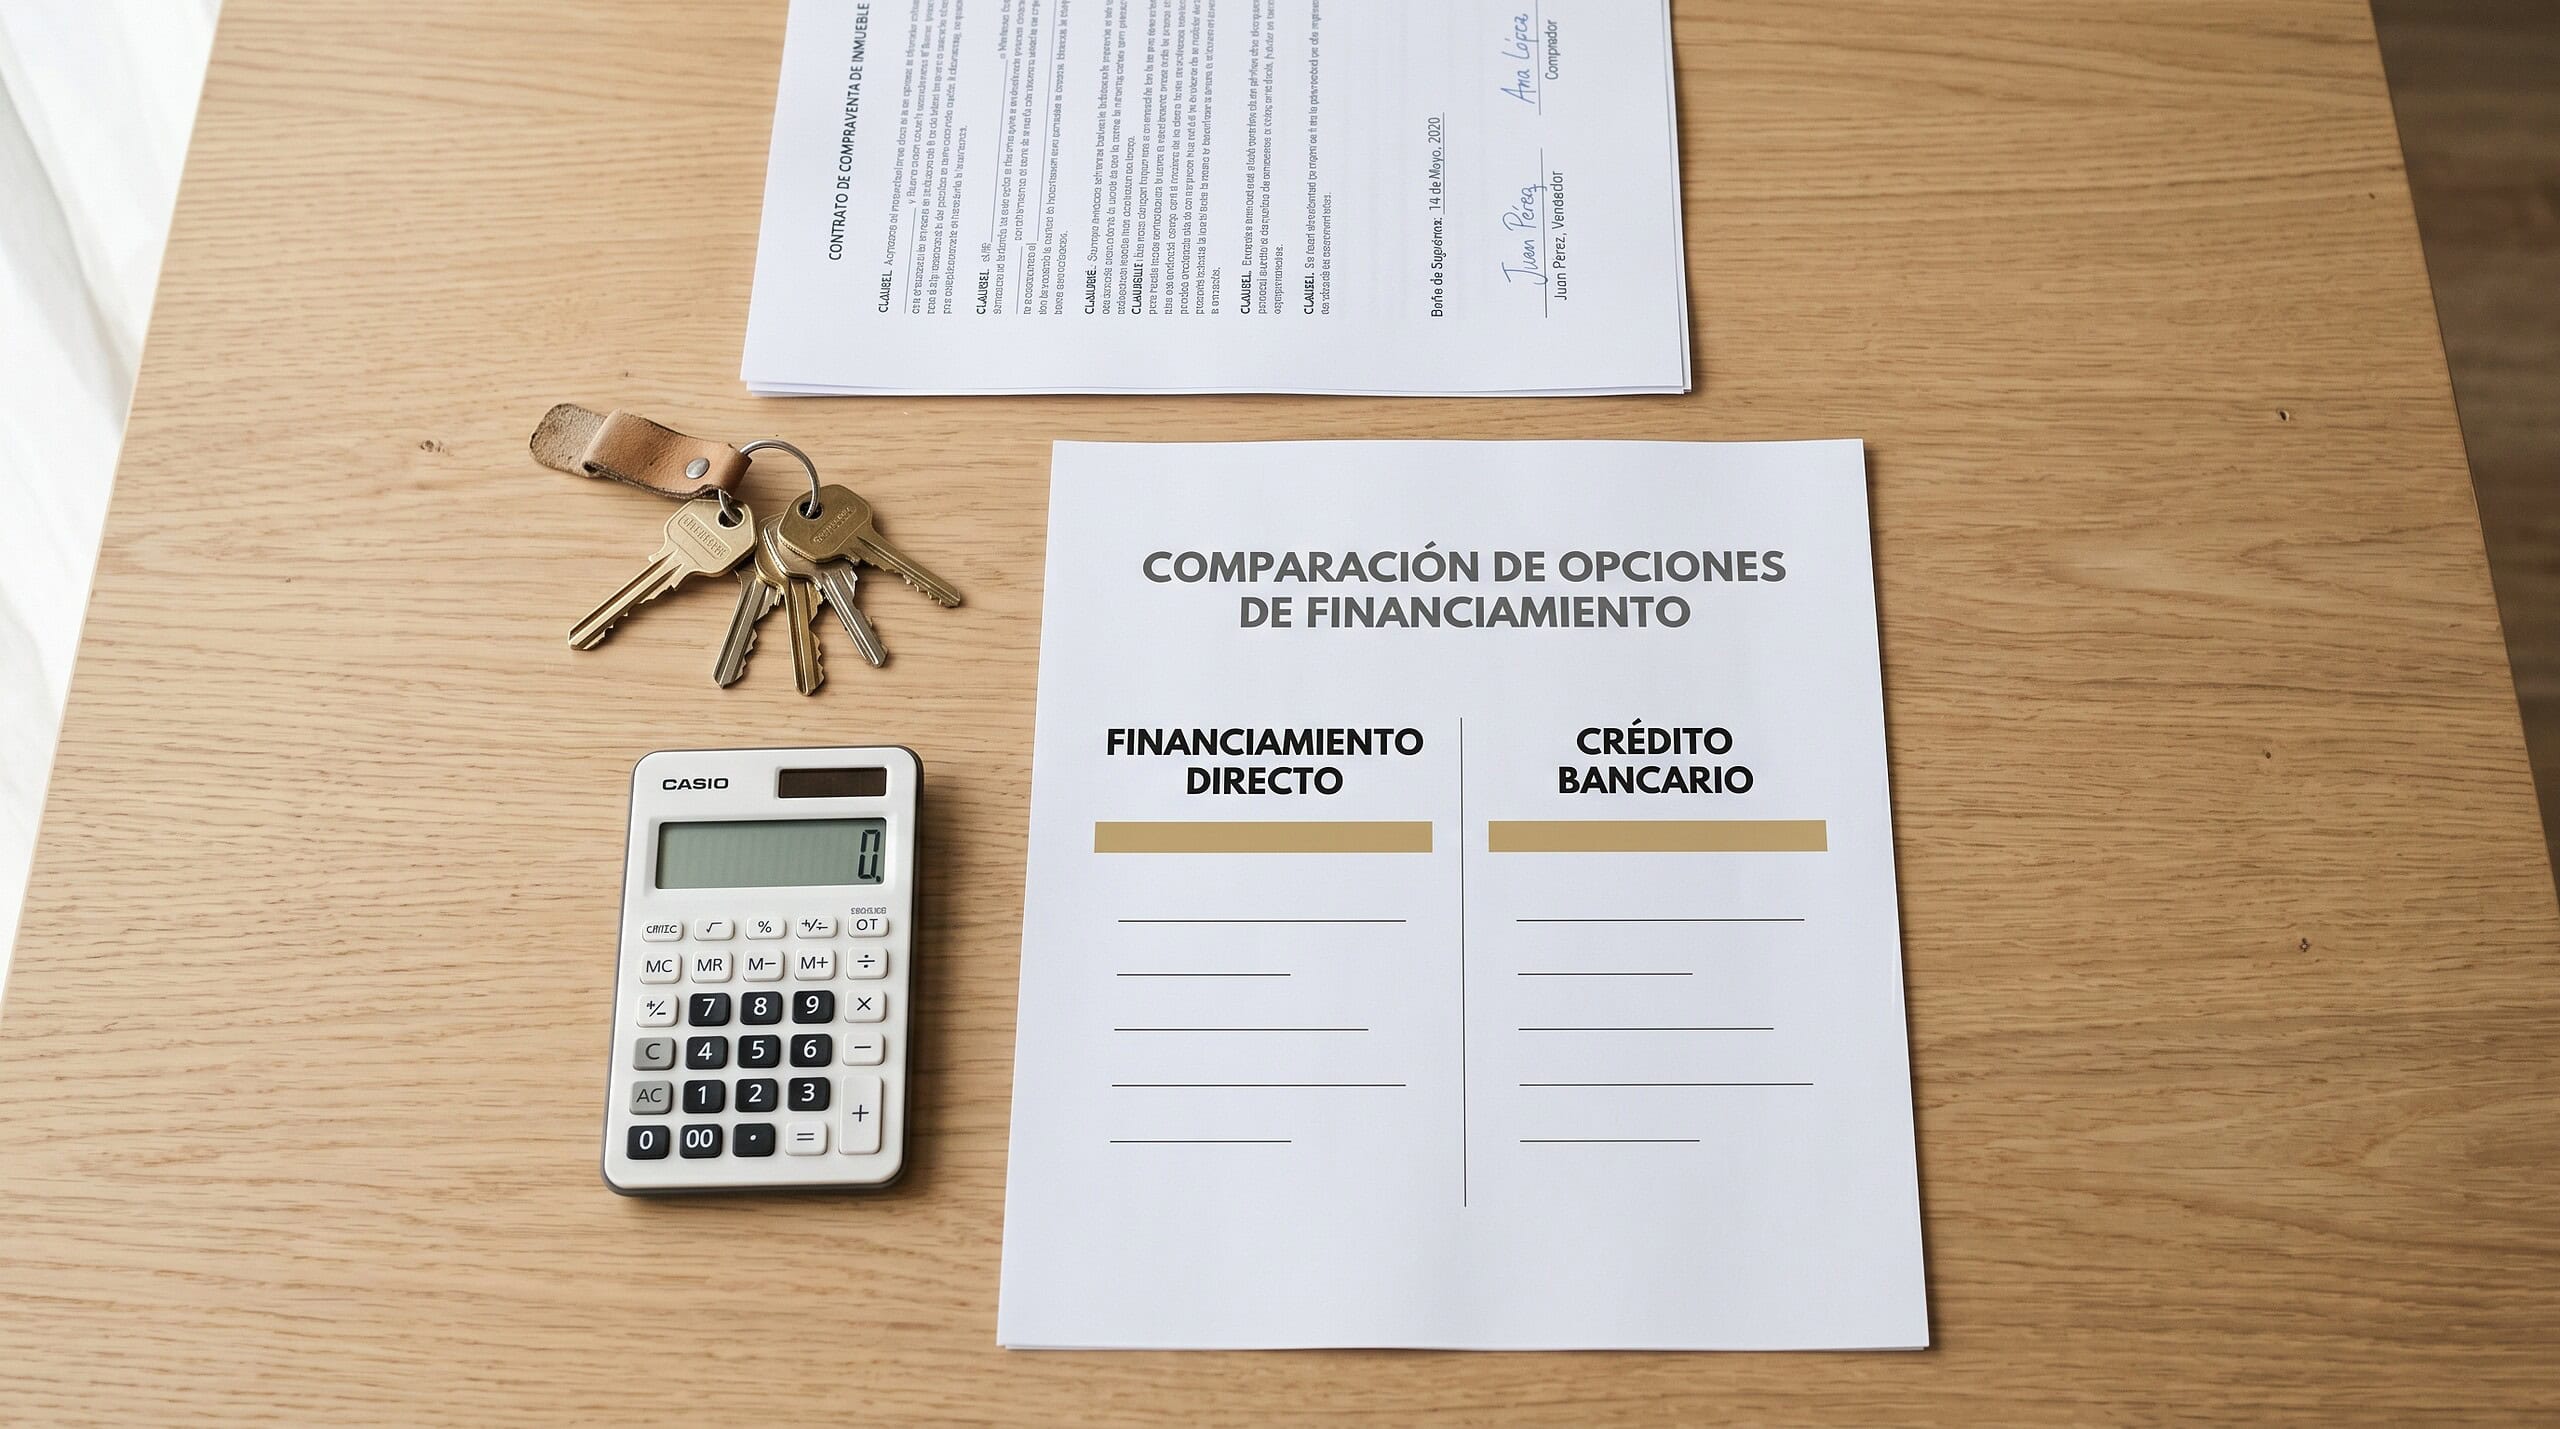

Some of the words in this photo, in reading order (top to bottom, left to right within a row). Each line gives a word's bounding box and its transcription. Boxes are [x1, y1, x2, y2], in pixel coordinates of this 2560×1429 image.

[851, 3, 870, 62] INMUEBLE
[849, 65, 863, 80] DE
[839, 83, 861, 172] COMPRAVENTA
[1428, 117, 1441, 143] 2020
[837, 175, 851, 189] DE
[1429, 181, 1442, 194] de
[1429, 197, 1441, 211] 14
[828, 193, 849, 260] CONTRATO
[1430, 272, 1443, 286] de
[1554, 273, 1567, 300] Juan
[1142, 541, 1479, 582] COMPARACIÓN
[1493, 551, 1545, 582] DE
[1558, 550, 1786, 582] OPCIONES
[1239, 598, 1292, 628] DE
[1308, 595, 1691, 628] FINANCIAMIENTO
[1107, 728, 1424, 756] FINANCIAMIENTO
[1576, 719, 1733, 755] CRÉDITO
[662, 778, 728, 790] CASIO
[1186, 766, 1344, 795] DIRECTO
[1558, 766, 1754, 794] BANCARIO
[646, 960, 673, 973] MC
[697, 958, 723, 971] MR
[800, 956, 829, 969] M+
[702, 998, 716, 1016] 7
[754, 997, 767, 1015] 8
[806, 996, 819, 1014] 9
[645, 1043, 661, 1060] C
[697, 1042, 712, 1061] 4
[751, 1040, 764, 1059] 5
[804, 1040, 817, 1058] 6
[636, 1088, 662, 1103] AC
[697, 1086, 706, 1105] 1
[748, 1085, 762, 1103] 2
[801, 1083, 815, 1101] 3
[639, 1130, 653, 1149] 0
[686, 1130, 713, 1148] 00
